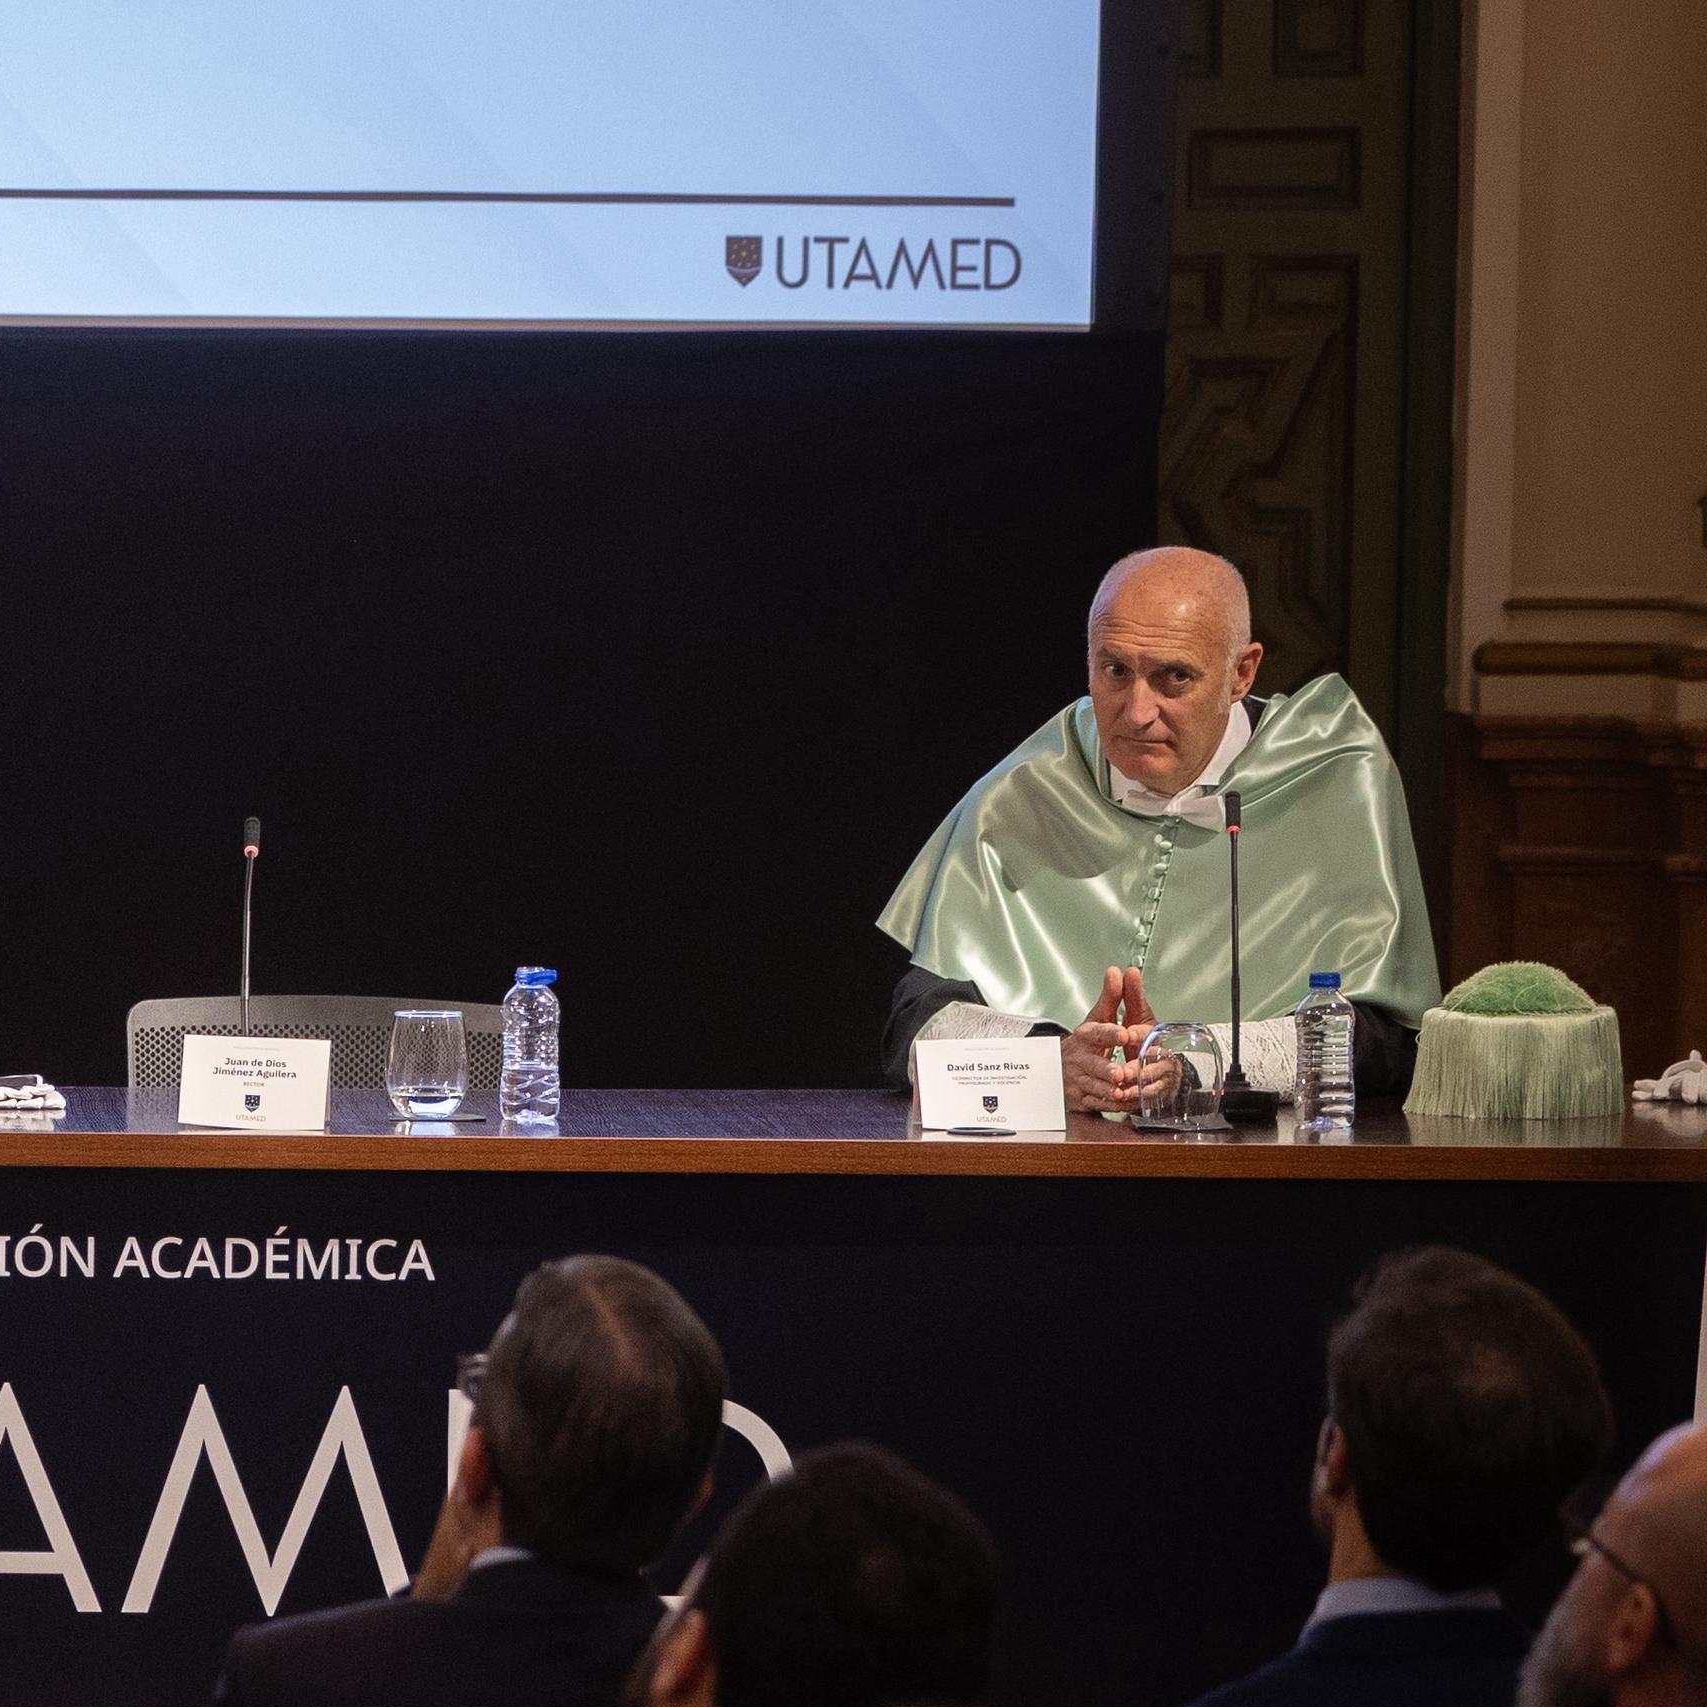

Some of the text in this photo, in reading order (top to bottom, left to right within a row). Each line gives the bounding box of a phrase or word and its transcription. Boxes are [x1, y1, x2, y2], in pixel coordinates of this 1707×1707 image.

[776, 236, 1023, 292] UTAMED
[224, 1057, 287, 1068] Juan de Dios
[946, 1062, 1030, 1072] David Sanz Rivas
[212, 1066, 297, 1079] Jiménez Aguilera
[113, 1225, 436, 1282] ACADÉMICA
